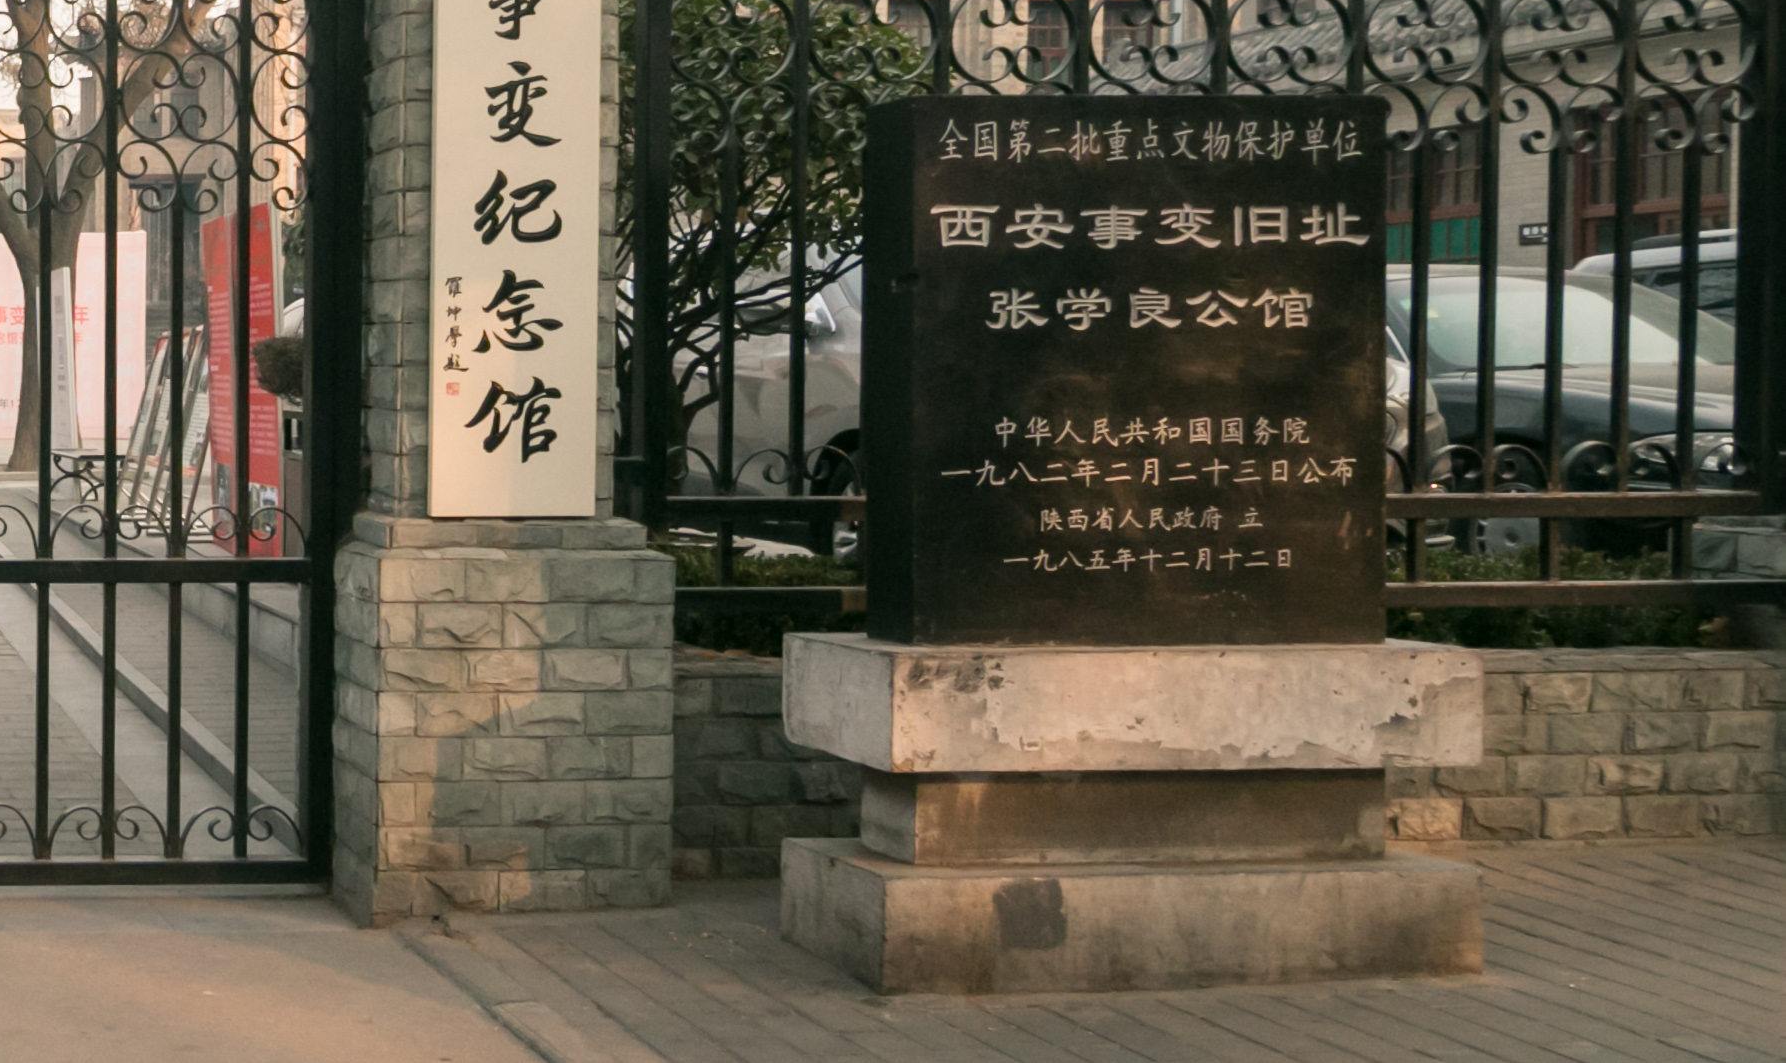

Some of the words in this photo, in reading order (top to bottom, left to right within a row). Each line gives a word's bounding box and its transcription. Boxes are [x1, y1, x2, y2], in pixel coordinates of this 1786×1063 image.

[939, 118, 1362, 164] 全国第二批重点文物保护单位
[930, 203, 1369, 249] 西安事变旧址
[985, 287, 1312, 331] 张学良公馆
[995, 416, 1310, 448] 中华人民共和国国务院
[941, 456, 1357, 488] 一九八二年二月二十三日公布
[1040, 505, 1223, 532] 陕西省人民政府
[1237, 506, 1264, 529] 立
[1003, 547, 1291, 572] 一九八五年十二月十二日
